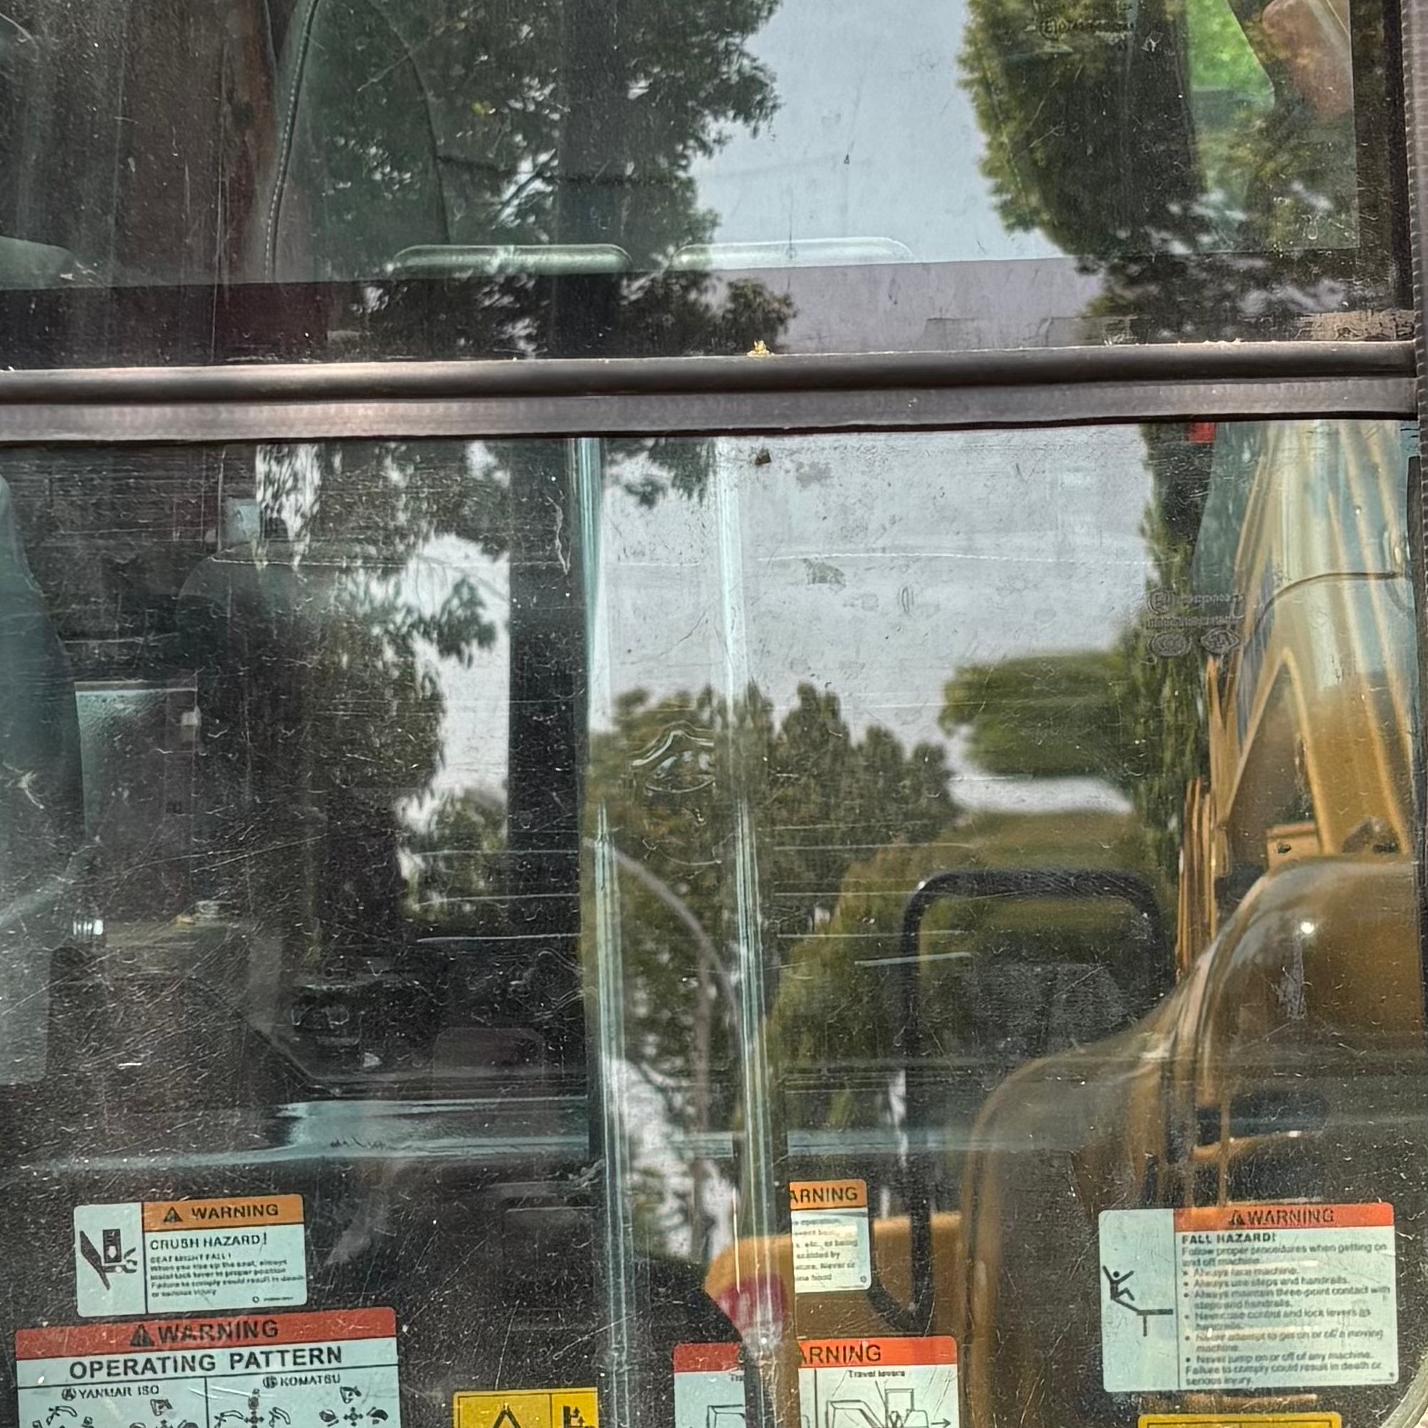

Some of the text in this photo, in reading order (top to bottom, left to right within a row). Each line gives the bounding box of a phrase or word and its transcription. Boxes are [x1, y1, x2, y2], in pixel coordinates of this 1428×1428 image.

[191, 1204, 278, 1220] WARNING
[1248, 1208, 1334, 1224] WARNING
[150, 1238, 199, 1250] CRUSH
[1182, 1233, 1276, 1244] FALL HAZARD!
[1182, 1247, 1214, 1256] Follow
[1216, 1247, 1248, 1256] proper
[1309, 1244, 1336, 1252] when
[1338, 1243, 1372, 1253] getting
[1374, 1243, 1387, 1251] on
[1194, 1278, 1229, 1289] Always
[1194, 1289, 1229, 1299] Always
[1332, 1286, 1368, 1295] contact
[158, 1319, 278, 1344] WARNING
[801, 1344, 881, 1364] RNING
[70, 1346, 342, 1380] OPERATING PATTERN
[279, 1374, 341, 1387] KOMATSU
[848, 1370, 876, 1378] Travel
[78, 1385, 132, 1399] YANMAR
[138, 1384, 160, 1397] ISO
